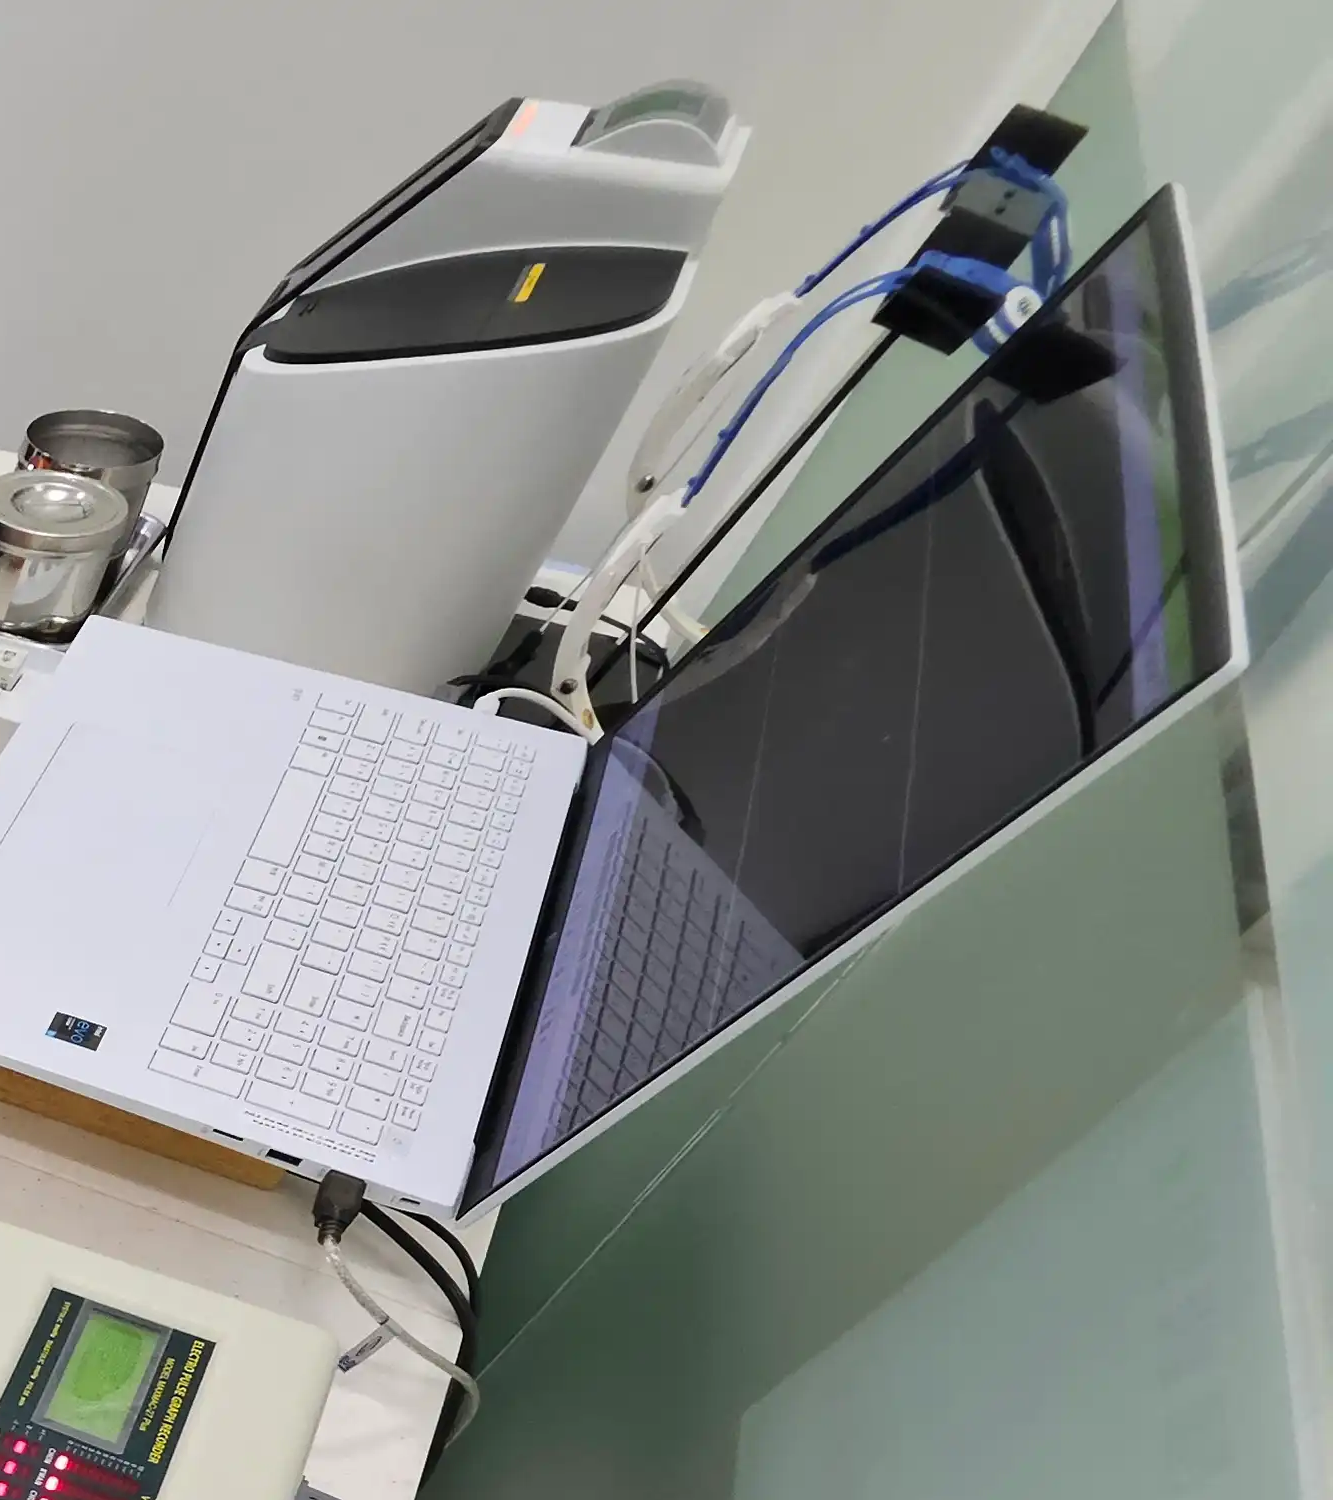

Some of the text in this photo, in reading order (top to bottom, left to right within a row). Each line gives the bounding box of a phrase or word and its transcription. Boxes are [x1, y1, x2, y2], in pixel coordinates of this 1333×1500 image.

[70, 1020, 90, 1043] evo
[159, 1357, 175, 1380] MODEL
[147, 1339, 205, 1464] ELECTRO PULSE GRAPH RECORDER
